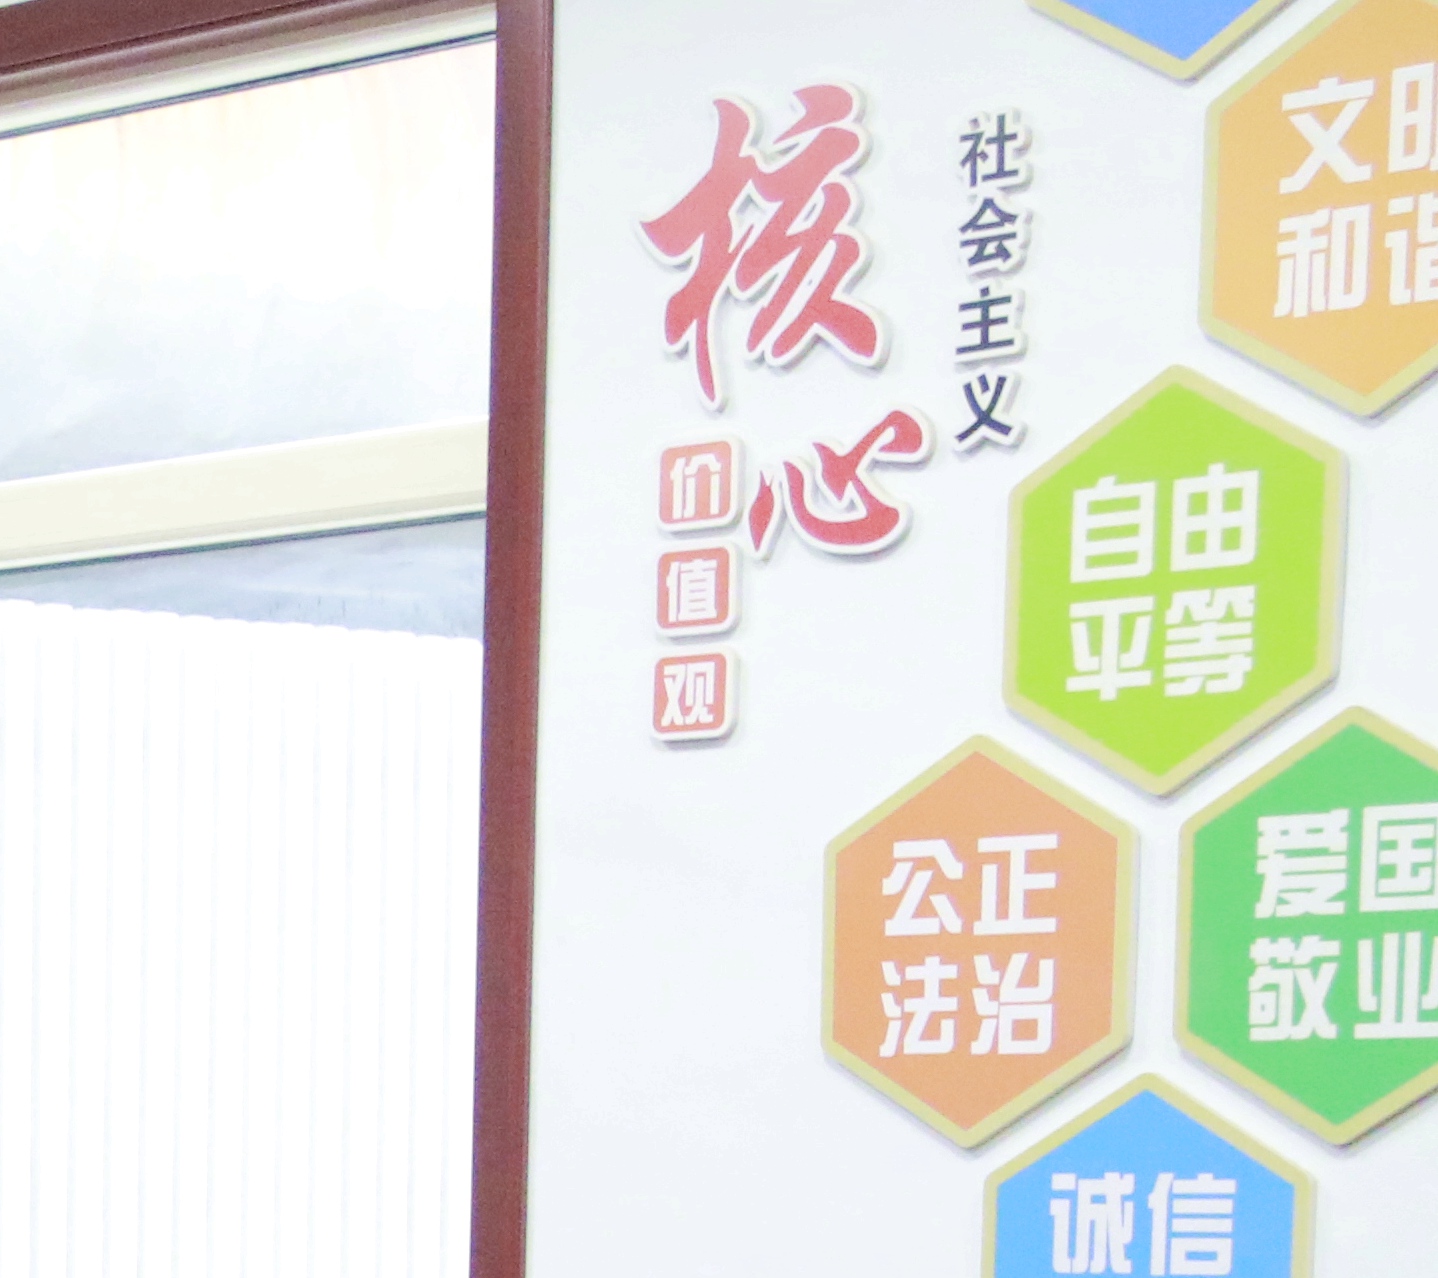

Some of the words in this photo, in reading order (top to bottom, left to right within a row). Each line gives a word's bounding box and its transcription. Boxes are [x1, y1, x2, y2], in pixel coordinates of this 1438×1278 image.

[640, 83, 924, 556] 核心
[954, 114, 1019, 444] 社会主义
[1070, 462, 1261, 583] 自由
[660, 451, 723, 728] 价值观
[1065, 585, 1258, 702] 平等
[881, 833, 1059, 937] 公正
[1254, 802, 1438, 919] 爱国
[878, 951, 1055, 1059] 法治
[1248, 930, 1438, 1042] 敬业
[1048, 1171, 1237, 1277] 诚信
